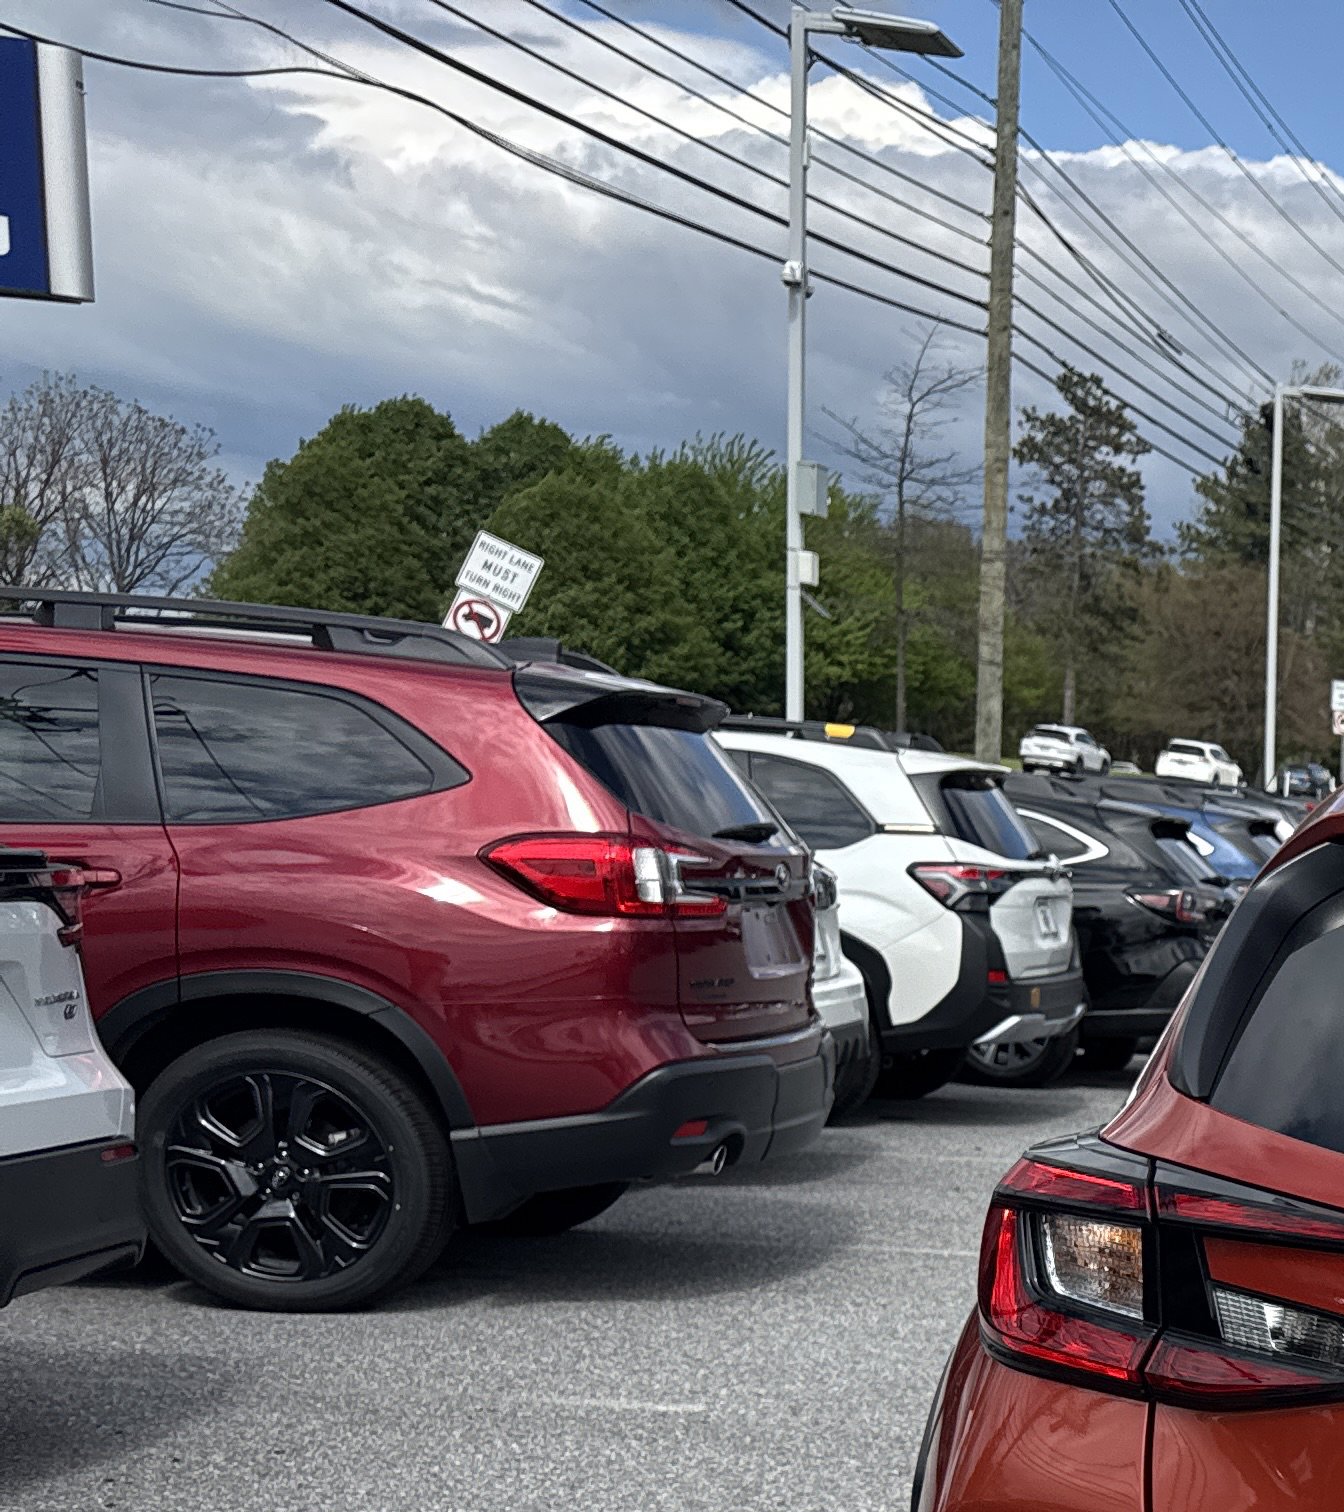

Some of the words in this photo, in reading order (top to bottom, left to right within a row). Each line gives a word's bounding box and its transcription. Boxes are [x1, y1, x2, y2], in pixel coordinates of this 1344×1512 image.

[479, 540, 508, 560] RIGHT
[508, 555, 536, 575] LANE
[481, 559, 519, 584] MUST
[464, 569, 491, 589] TURN
[491, 583, 522, 604] RIGHT
